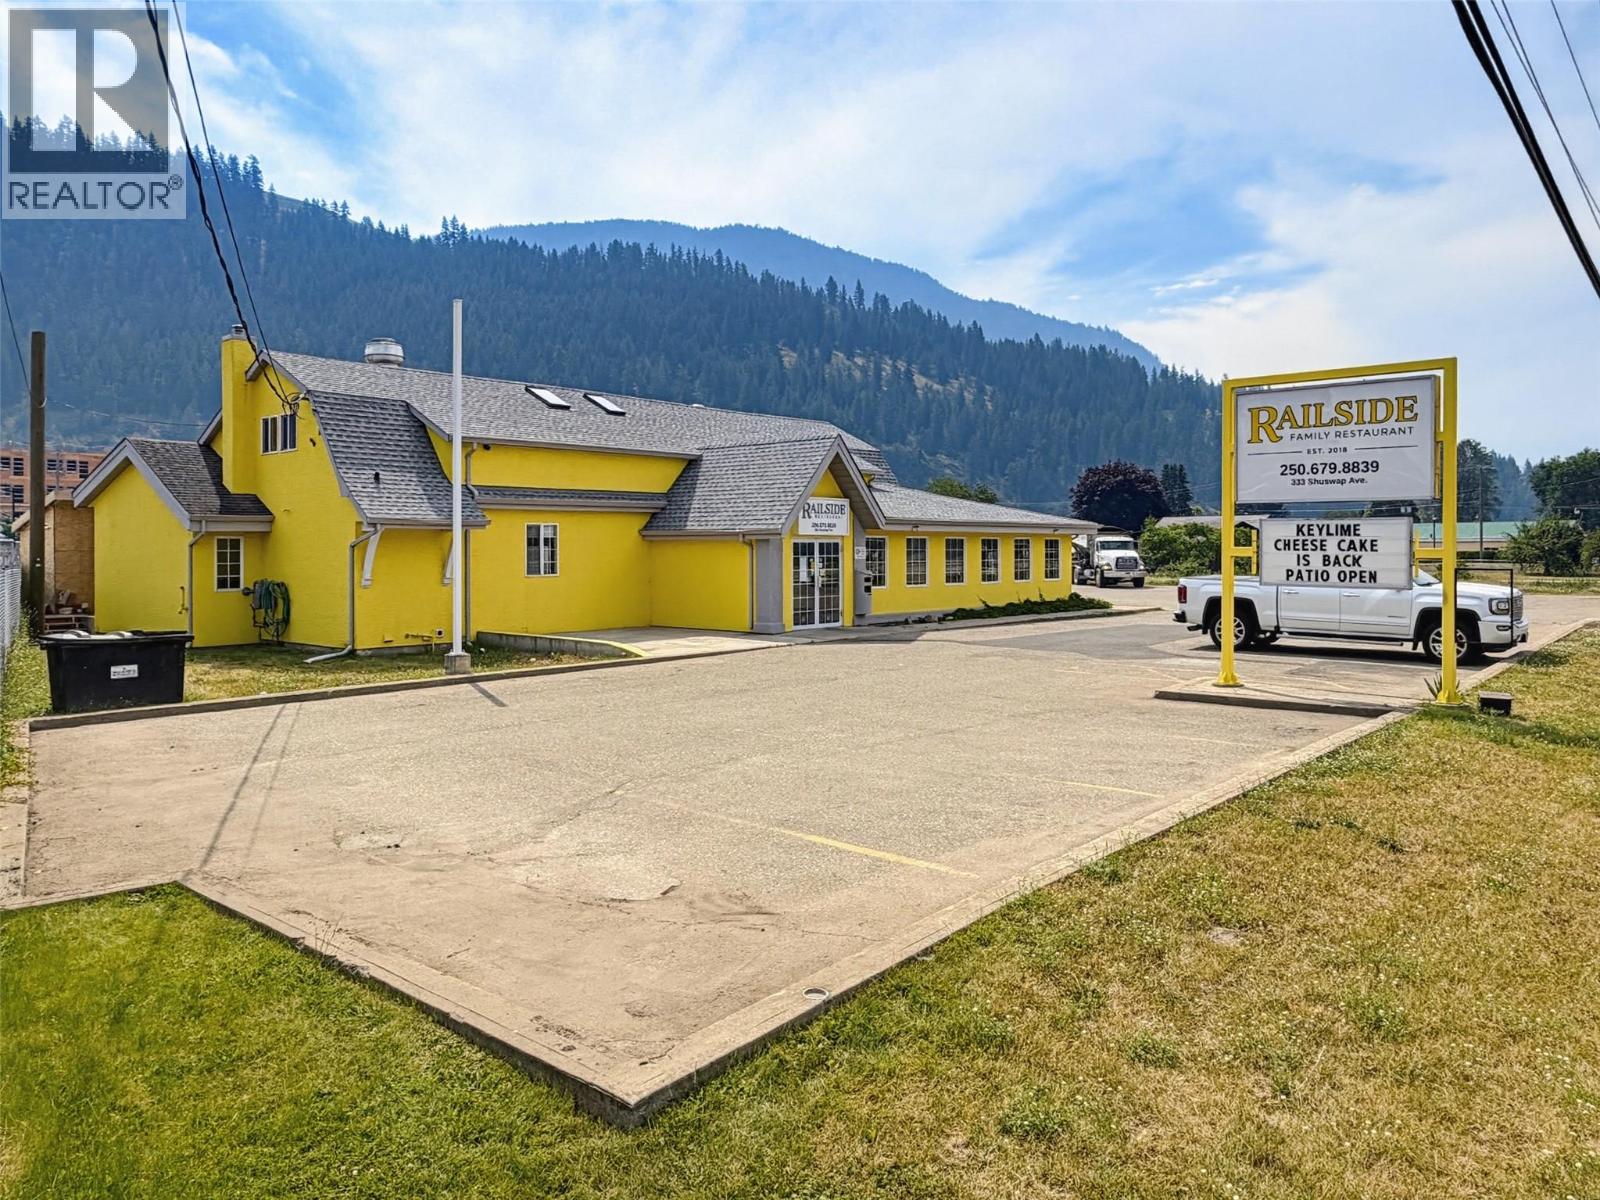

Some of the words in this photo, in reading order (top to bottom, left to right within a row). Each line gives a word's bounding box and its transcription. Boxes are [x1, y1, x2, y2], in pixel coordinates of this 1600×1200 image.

[1247, 395, 1419, 444] RAILSIDE
[1290, 431, 1330, 441] FAMILY
[1334, 426, 1415, 439] RESTAURANT
[1279, 460, 1380, 476] 250.679.8839
[1308, 477, 1347, 487] Shuswap
[1348, 476, 1368, 485] Ave.
[801, 502, 846, 519] RAILSIDE
[1296, 523, 1361, 537] KEYLIME
[1274, 539, 1328, 551] CHEESE
[1337, 539, 1379, 552] CAKE
[1296, 554, 1311, 567] IS
[1322, 554, 1362, 568] BACK
[1285, 569, 1330, 583] PATIO
[1337, 569, 1378, 583] OPEN
